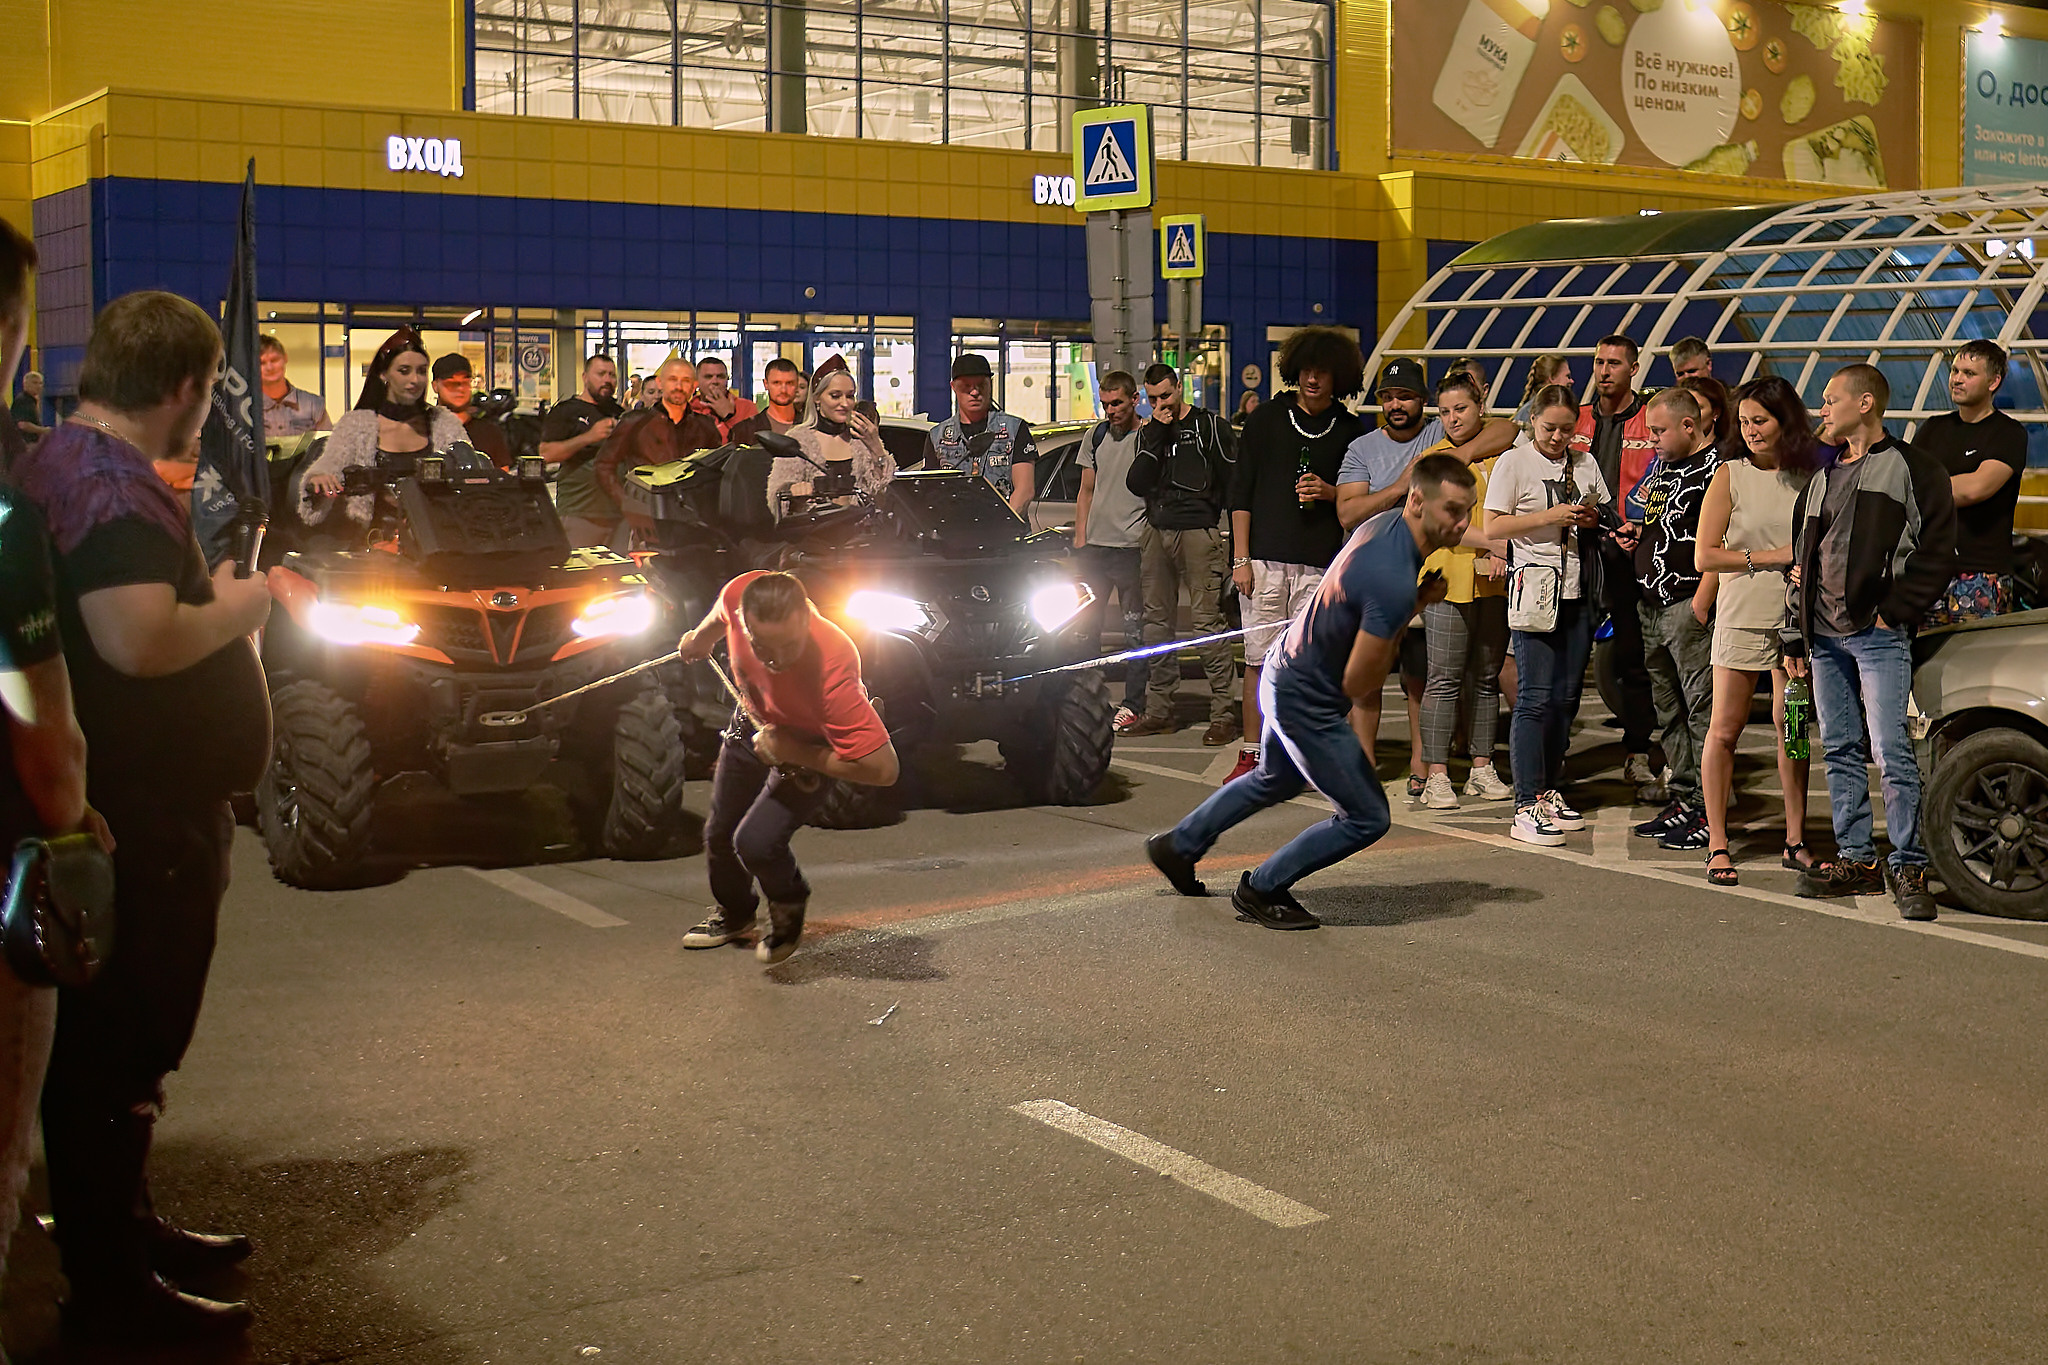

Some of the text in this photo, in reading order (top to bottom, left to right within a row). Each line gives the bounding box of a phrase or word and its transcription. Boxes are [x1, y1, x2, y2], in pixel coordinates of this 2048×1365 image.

[1479, 34, 1508, 64] МУКА
[1635, 50, 1734, 79] Всё нужное!
[1634, 72, 1720, 98] По низким
[1634, 94, 1687, 113] ценам
[1974, 124, 2035, 147] Закажите
[387, 135, 464, 177] ВХОД
[1973, 149, 1997, 163] или
[2000, 152, 2016, 165] на
[1033, 175, 1076, 207] ВХО
